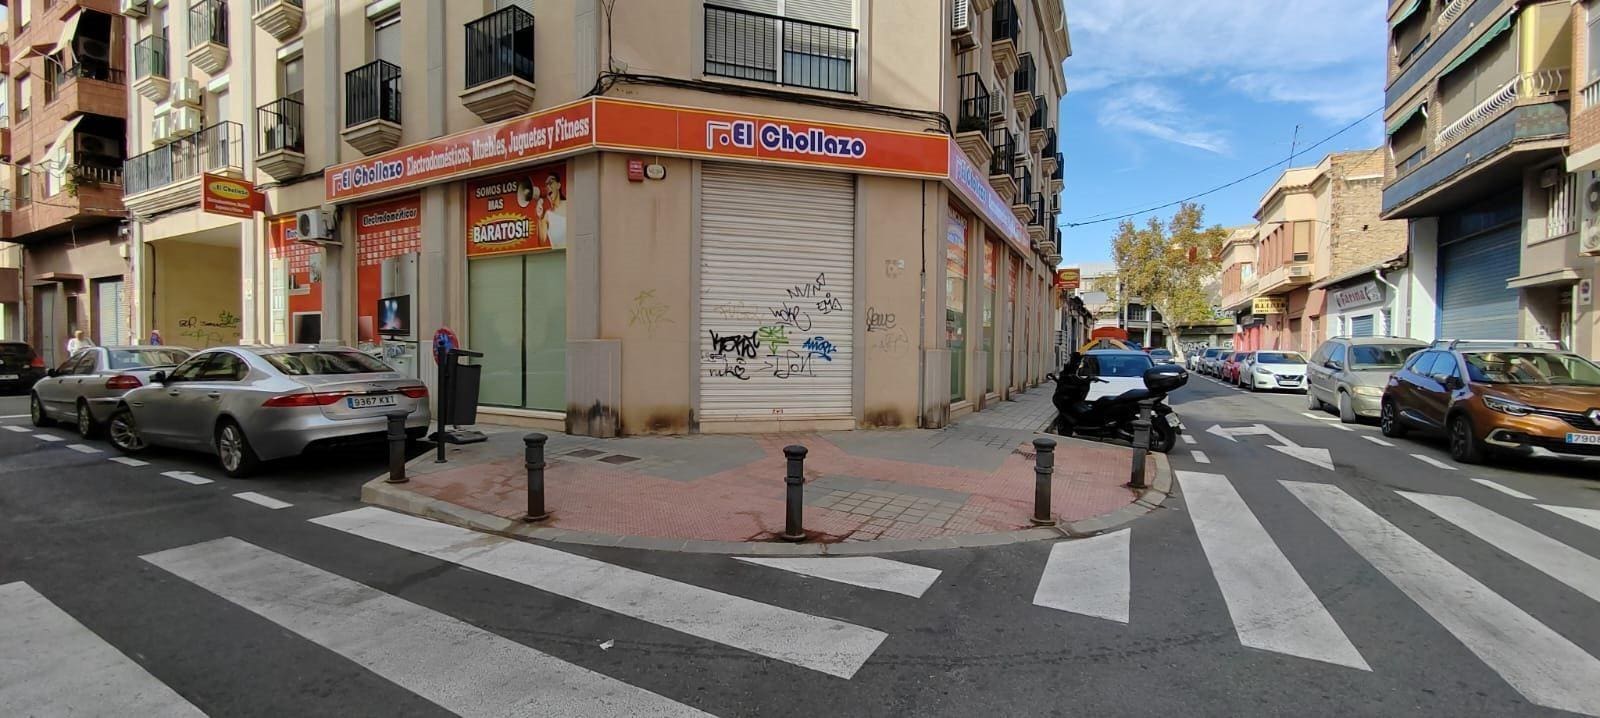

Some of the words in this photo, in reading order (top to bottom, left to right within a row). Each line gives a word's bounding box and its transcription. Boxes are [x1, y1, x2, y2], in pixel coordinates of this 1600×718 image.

[341, 172, 352, 190] El
[353, 160, 404, 188] Chollazo
[406, 143, 472, 177] Electrodomésticos,
[472, 134, 508, 163] Muebles,
[508, 127, 547, 159] Juguetes
[547, 126, 554, 149] y
[554, 116, 590, 144] Fitness
[732, 121, 754, 147] El
[760, 124, 866, 159] Chollazo
[476, 183, 501, 198] SOMOS
[502, 181, 518, 193] LOS
[487, 198, 504, 212] MAS
[472, 218, 530, 244] BARATOS!!
